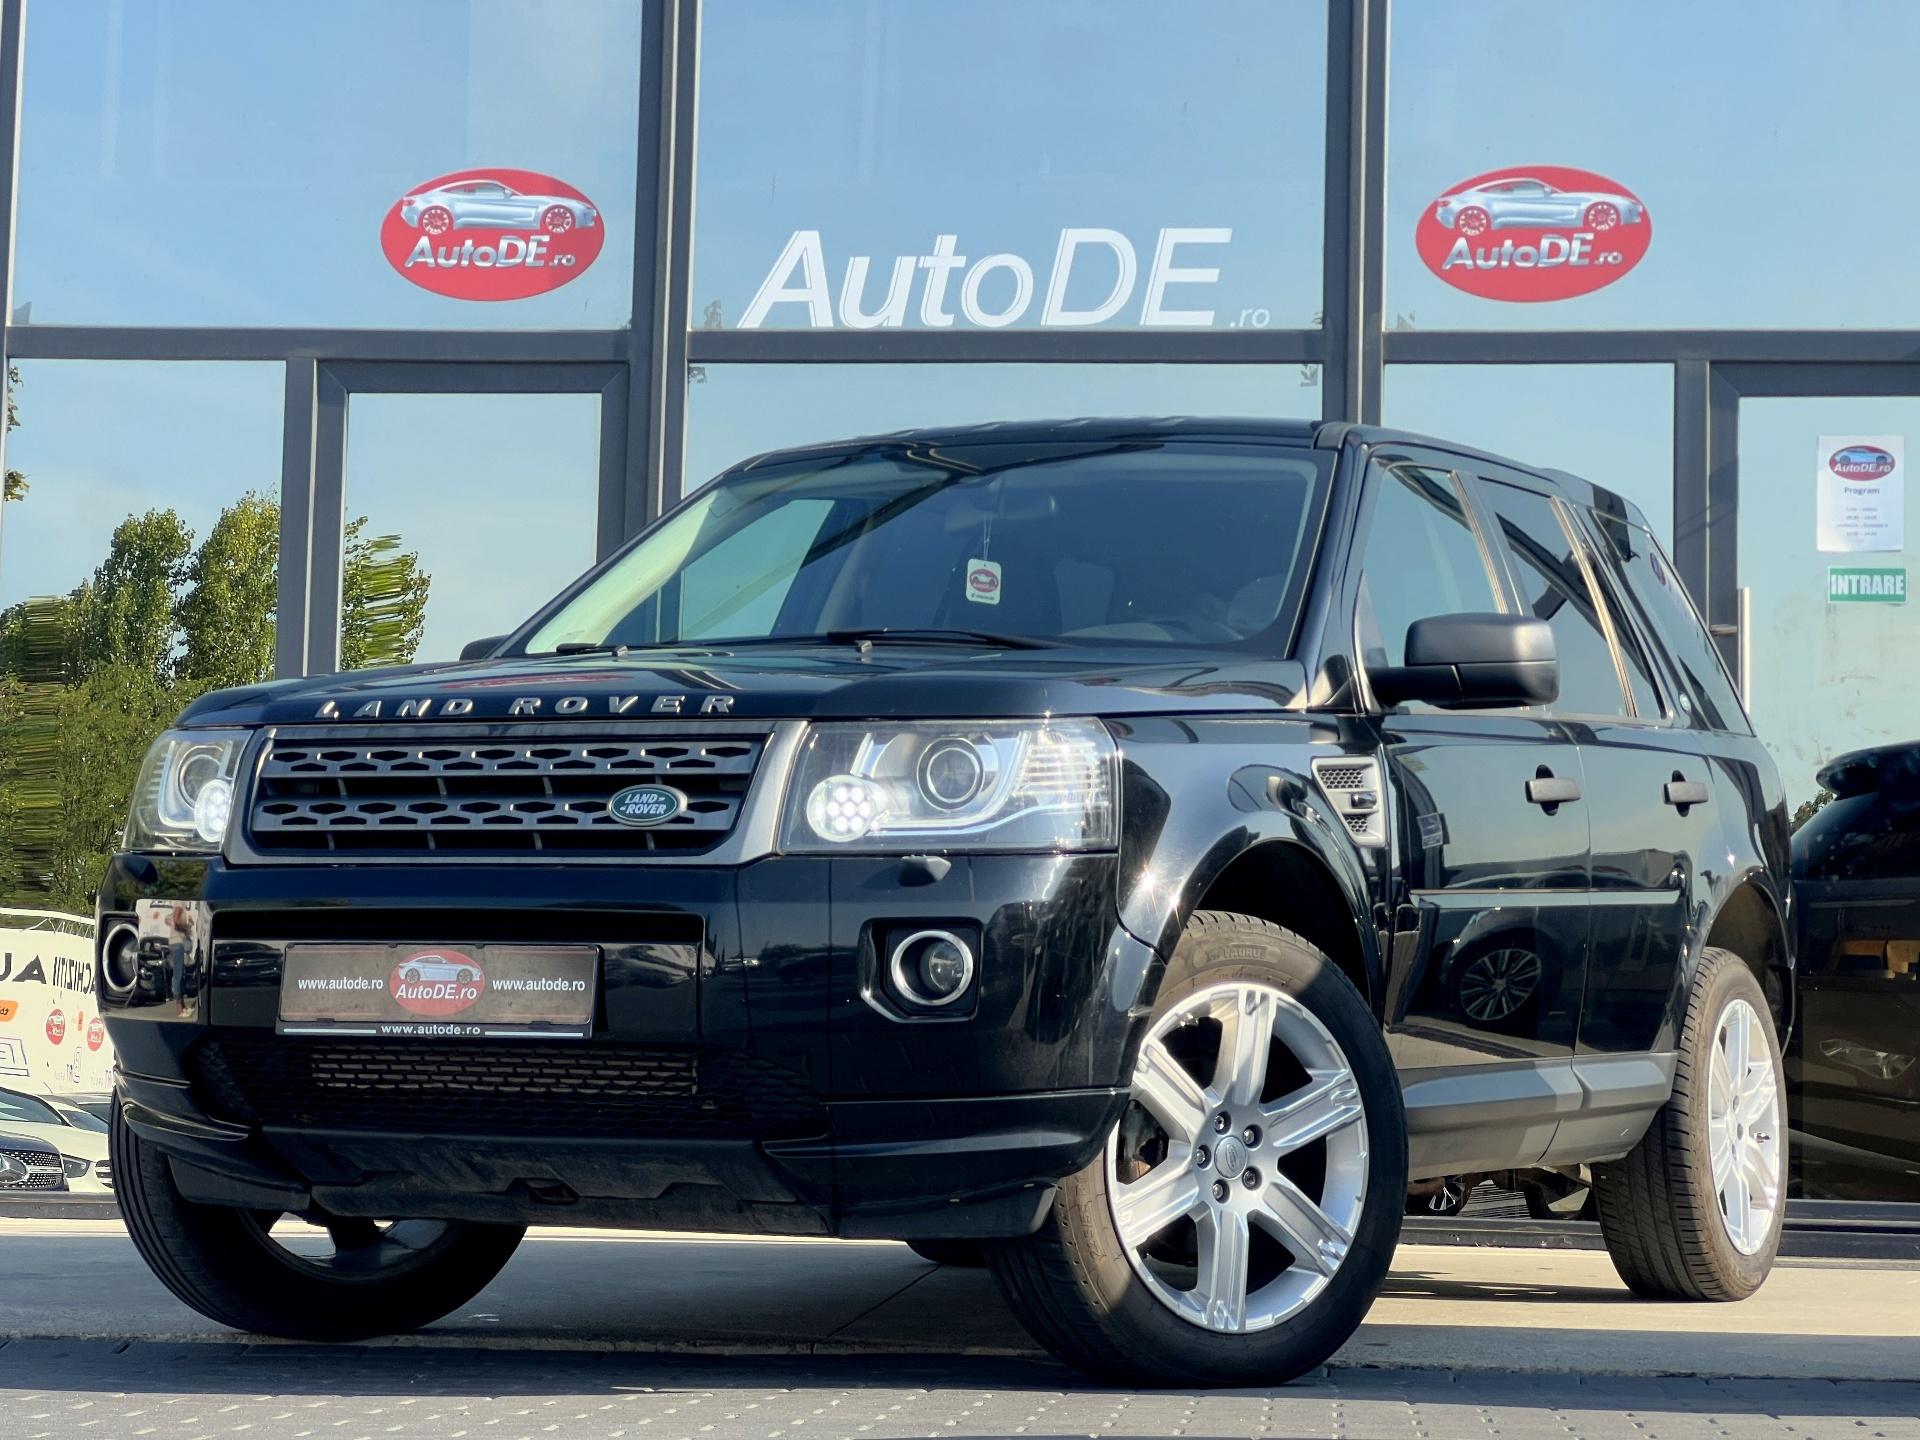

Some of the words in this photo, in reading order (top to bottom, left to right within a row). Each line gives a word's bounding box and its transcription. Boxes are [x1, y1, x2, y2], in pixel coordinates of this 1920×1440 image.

[1844, 487, 1880, 496] Program
[1831, 574, 1905, 595] INTRARE
[315, 699, 474, 718] LAND
[507, 695, 736, 715] ROVER
[298, 975, 384, 991] www.autode.ro
[395, 983, 478, 1001] AutoDE.ro
[492, 976, 586, 992] www.autode.ro
[381, 1023, 481, 1035] www.autode.ro
